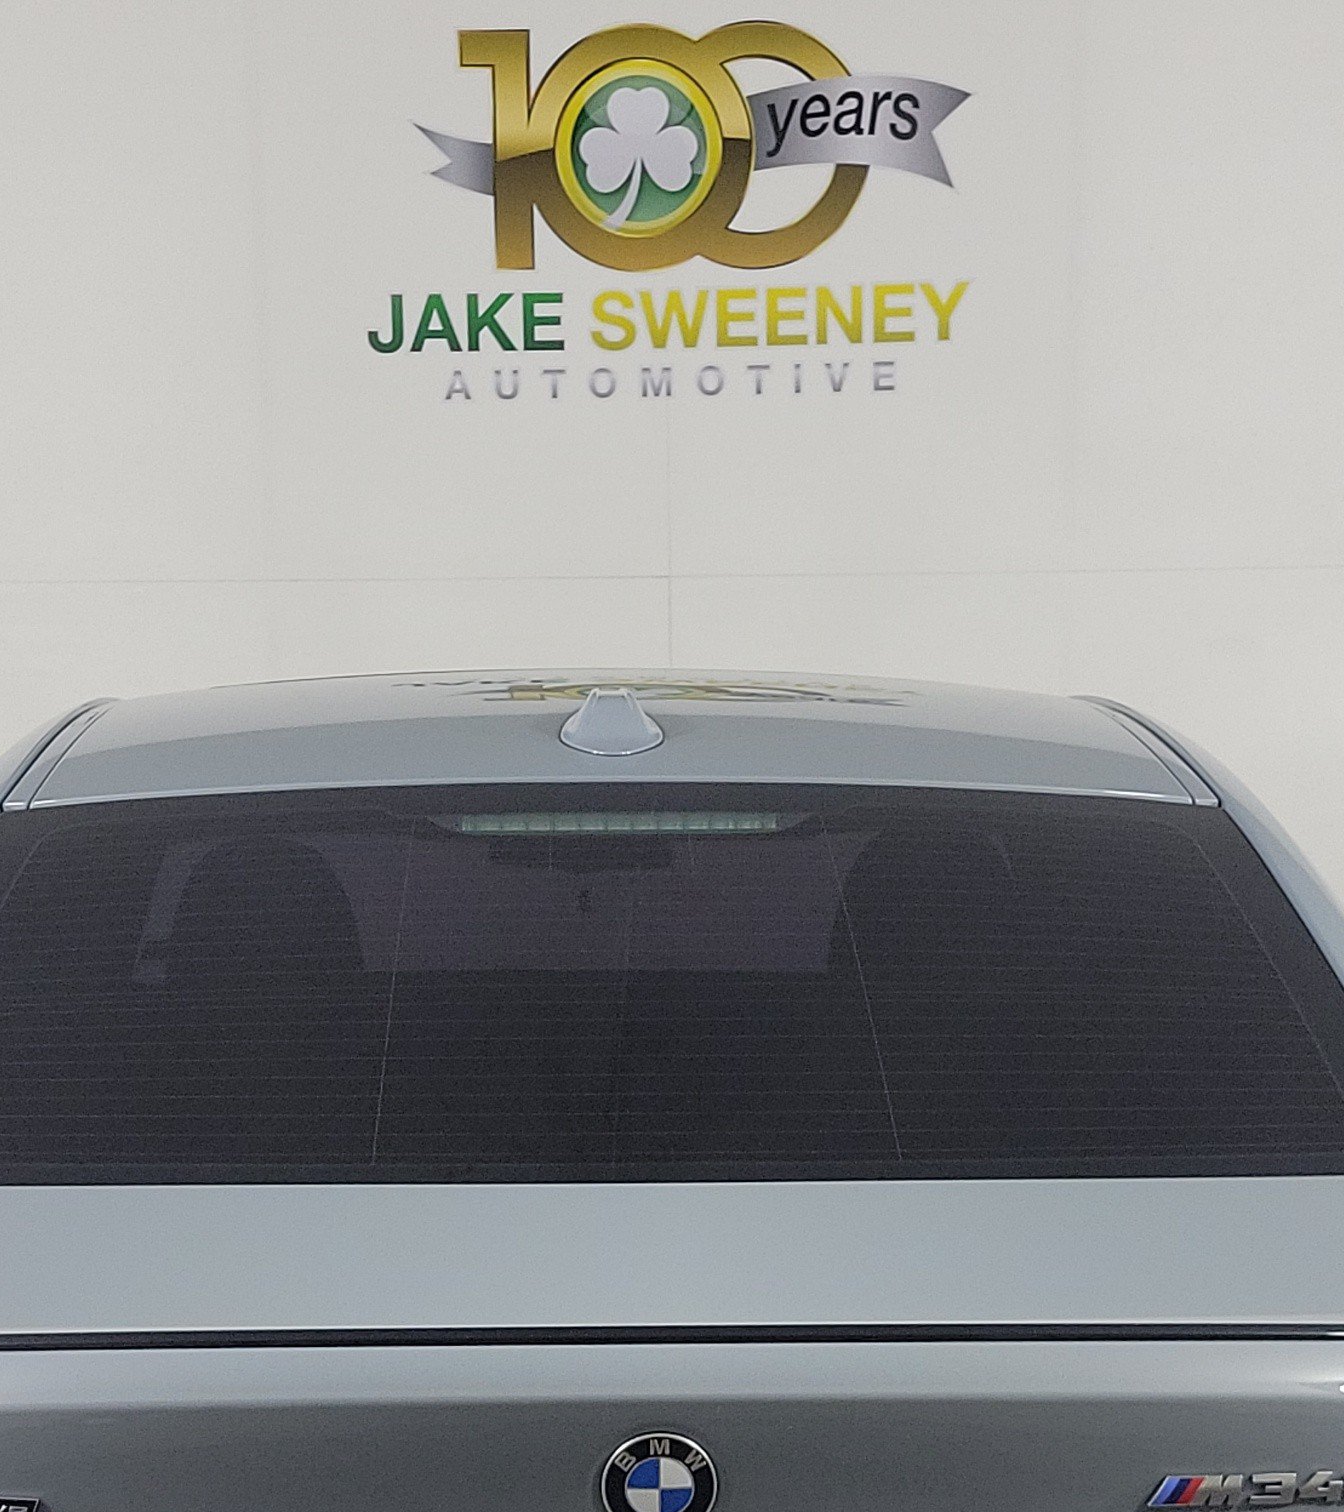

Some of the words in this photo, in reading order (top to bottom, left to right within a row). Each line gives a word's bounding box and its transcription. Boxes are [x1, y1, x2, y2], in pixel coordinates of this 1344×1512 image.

[458, 20, 870, 271] 100
[766, 88, 920, 157] years
[367, 292, 565, 354] JAKE
[590, 281, 970, 352] SWEENEY
[444, 360, 897, 402] AUTOMOTIVE
[614, 1439, 707, 1472] BMW
